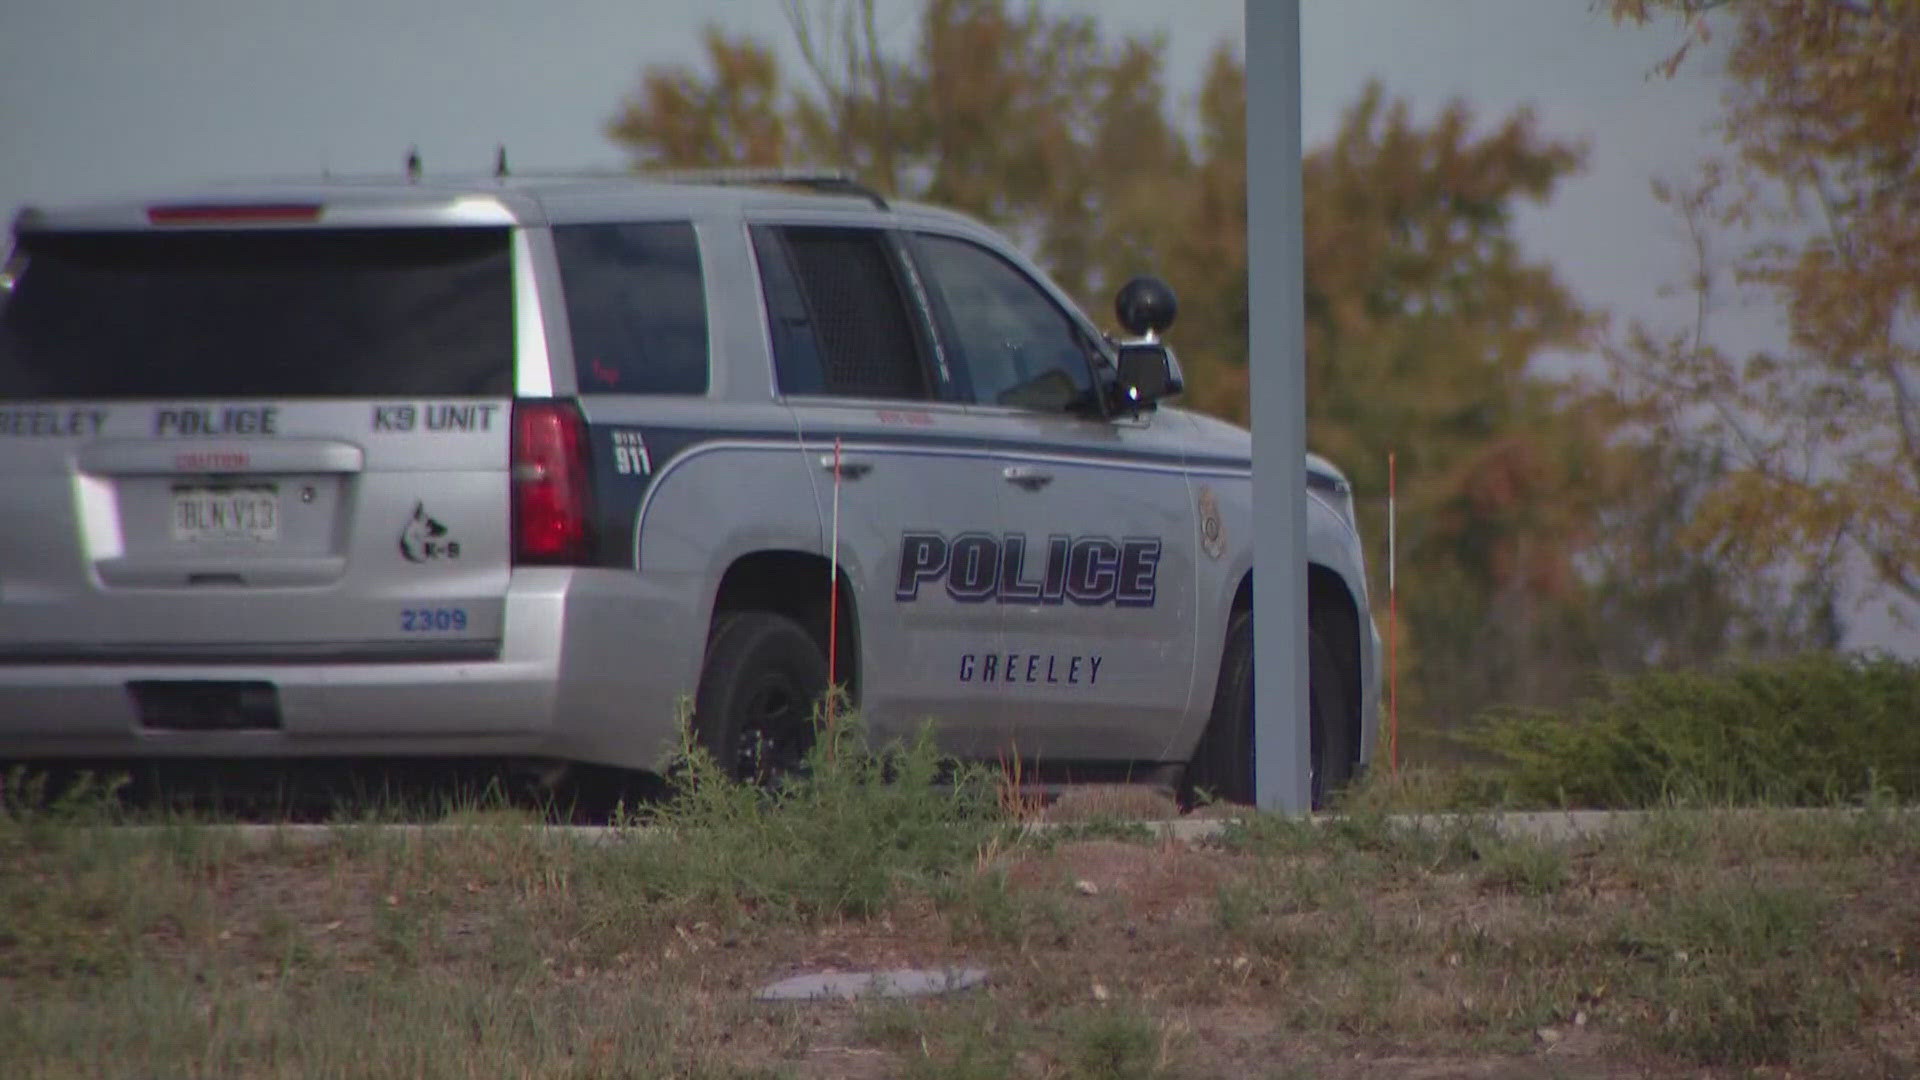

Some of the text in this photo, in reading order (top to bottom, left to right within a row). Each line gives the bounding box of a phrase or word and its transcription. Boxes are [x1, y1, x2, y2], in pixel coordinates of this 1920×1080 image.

[156, 406, 278, 435] POLICE
[374, 404, 416, 432] K9
[425, 403, 500, 432] UNIT
[616, 447, 651, 475] 911
[895, 530, 1161, 607] POLICE
[402, 608, 468, 632] 2309
[959, 653, 1103, 684] GREELEY
